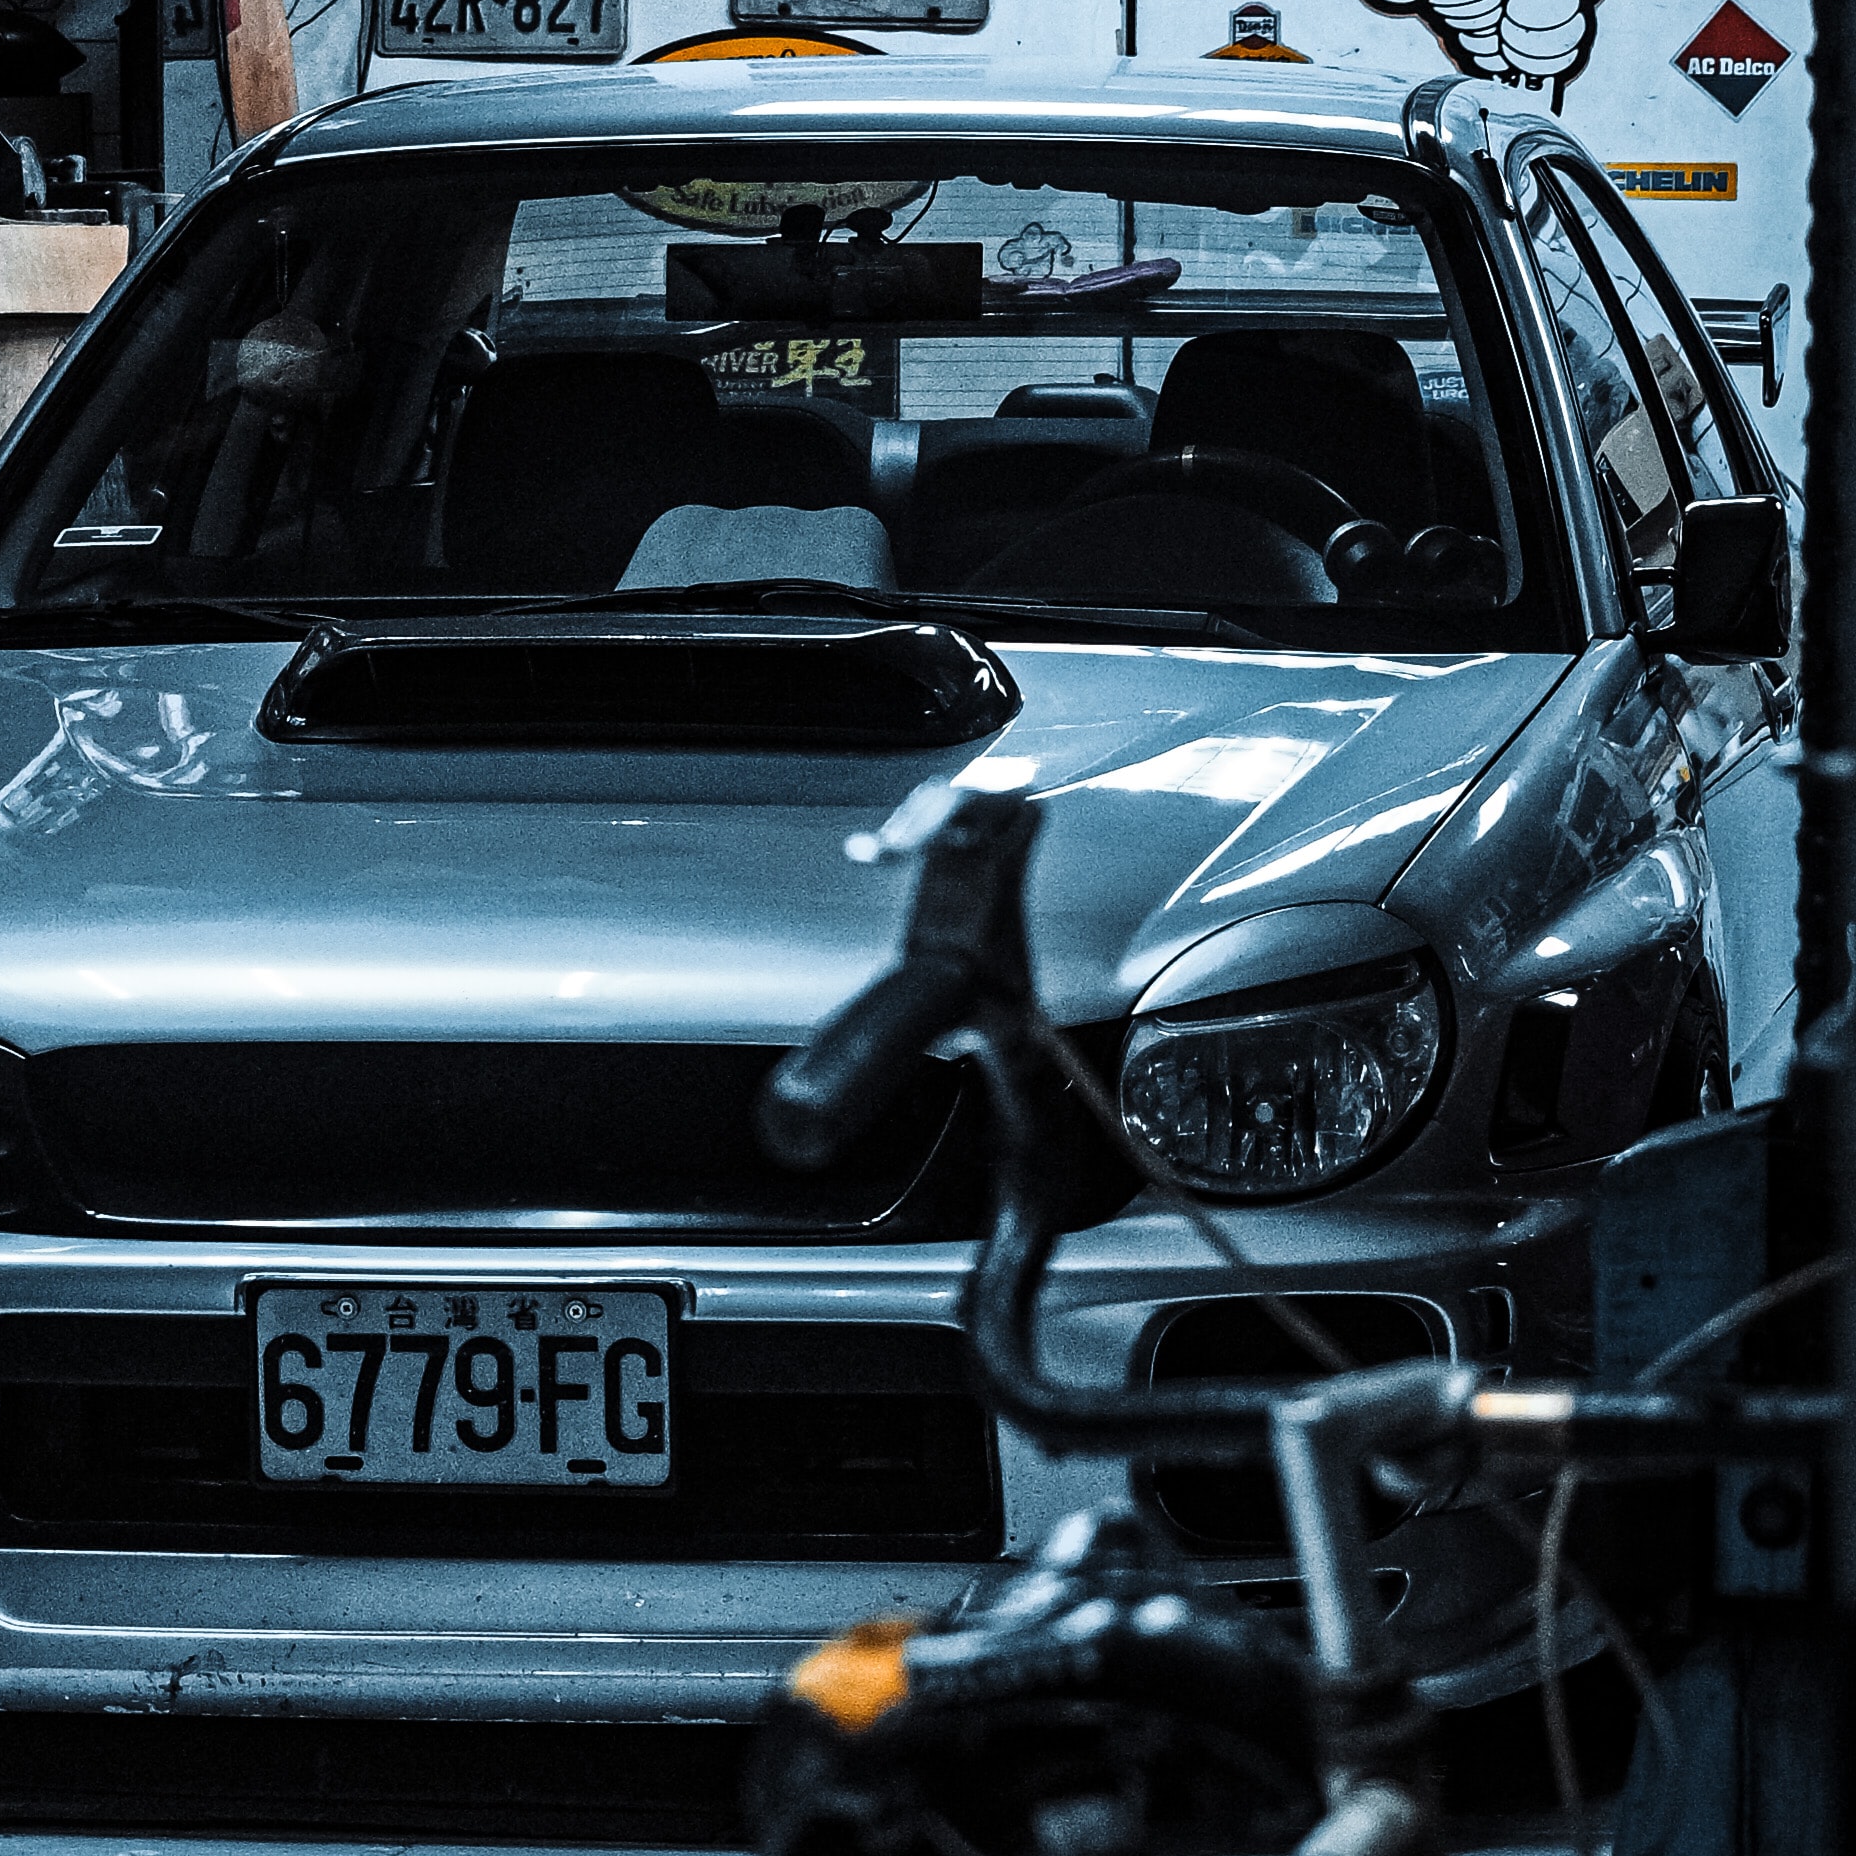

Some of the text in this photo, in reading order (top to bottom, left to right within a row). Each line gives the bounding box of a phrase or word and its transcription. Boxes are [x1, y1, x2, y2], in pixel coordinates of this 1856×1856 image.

[1688, 55, 1777, 77] AC Delco
[1612, 169, 1729, 194] CHELIN
